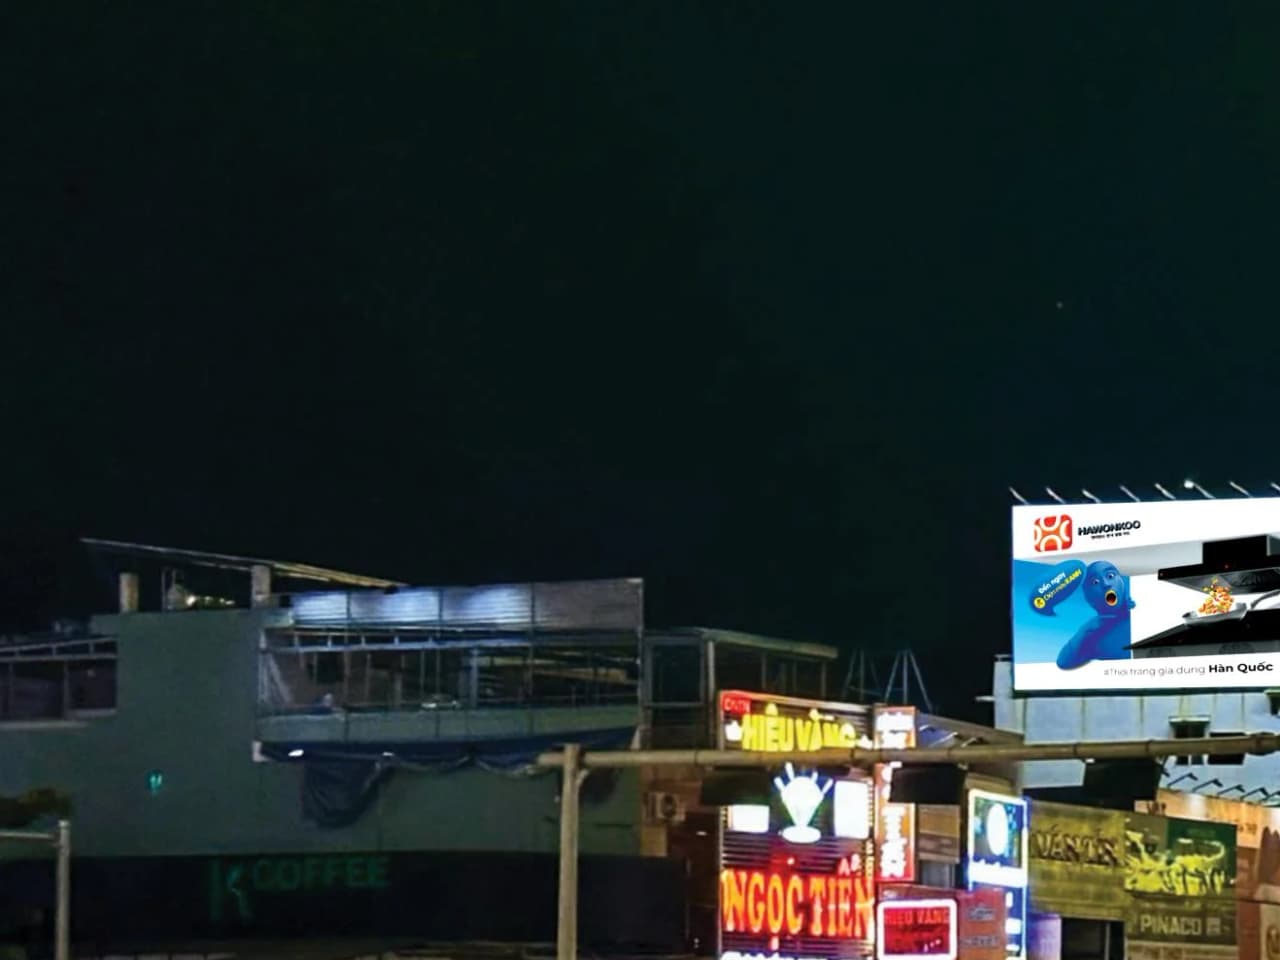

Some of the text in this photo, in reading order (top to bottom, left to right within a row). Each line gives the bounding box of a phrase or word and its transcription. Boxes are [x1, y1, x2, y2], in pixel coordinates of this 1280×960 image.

[1078, 520, 1141, 536] HAWONKOO
[1208, 663, 1234, 674] Hàn
[1236, 661, 1274, 674] Quốc
[1139, 914, 1202, 937] PINACO
